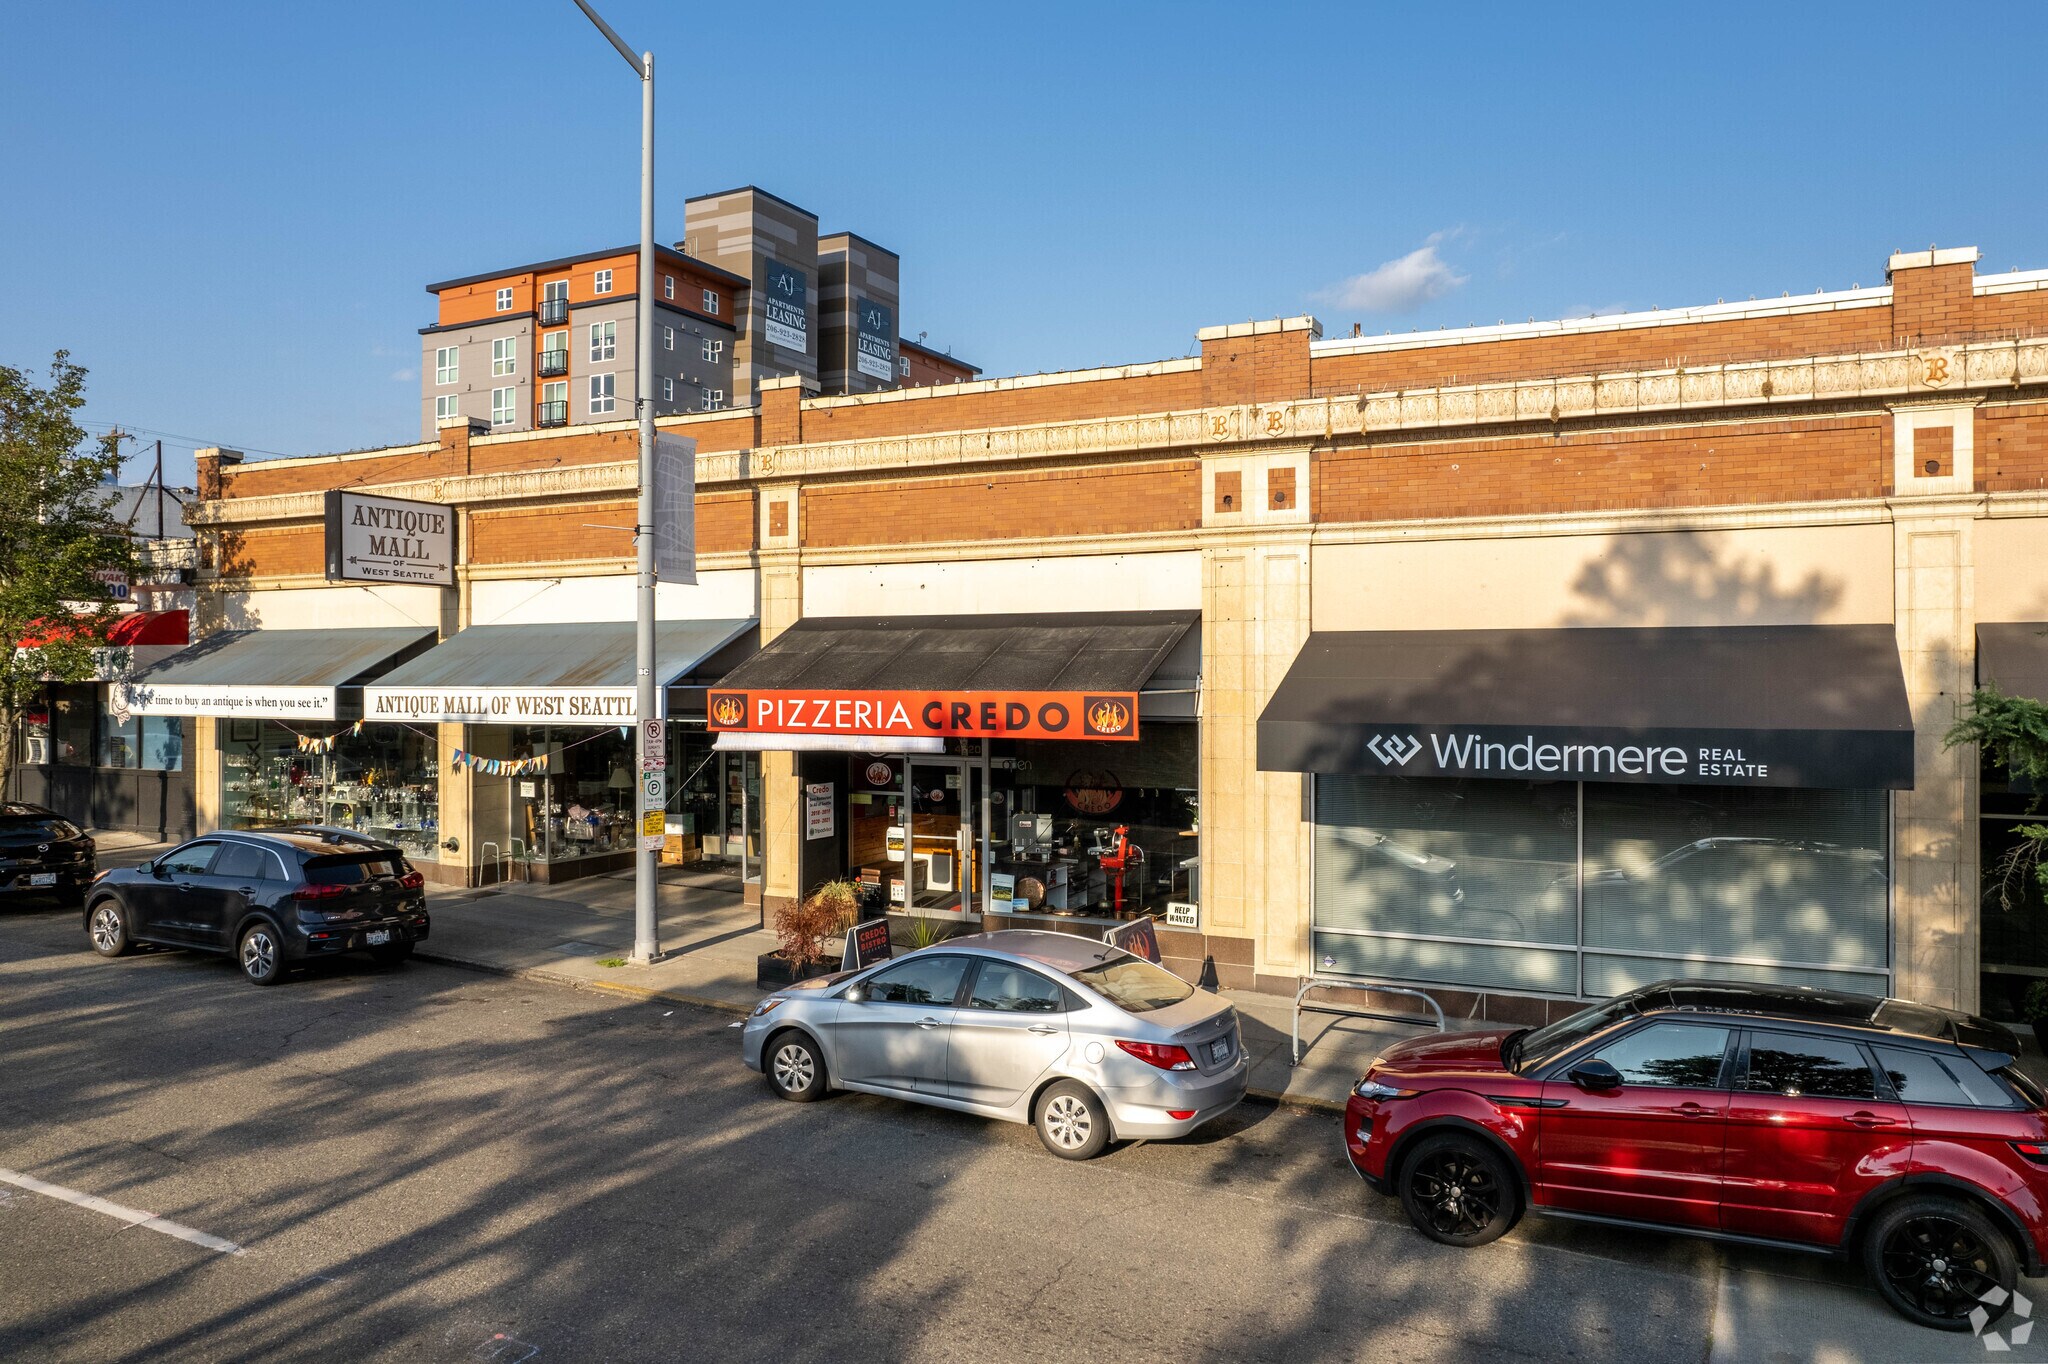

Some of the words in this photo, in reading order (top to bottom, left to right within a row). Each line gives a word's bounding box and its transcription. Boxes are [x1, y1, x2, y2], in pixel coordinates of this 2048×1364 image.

[777, 273, 794, 296] AJ
[767, 297, 805, 316] APARTMENTS
[766, 304, 806, 331] LEASING
[867, 309, 881, 330] AJ
[858, 337, 891, 361] LEASING
[859, 331, 890, 348] APARTMENTS
[350, 504, 445, 537] ANTIQUE
[368, 534, 430, 560] MALL
[392, 559, 405, 567] OF
[155, 694, 173, 706] time
[175, 696, 183, 706] to
[184, 694, 200, 710] buy
[201, 698, 211, 707] an
[213, 695, 244, 711] antique
[246, 696, 253, 708] is
[254, 696, 279, 709] when
[279, 699, 296, 714] you
[297, 700, 312, 709] see
[375, 695, 439, 718] ANTIQUE
[444, 696, 488, 715] MALL
[491, 696, 511, 715] OF
[516, 696, 565, 716] WEST
[569, 696, 637, 717] SEATTL
[719, 717, 739, 726] CREDO
[757, 698, 913, 730] PIZZERIA
[921, 700, 1070, 732] CREDO
[1096, 724, 1122, 734] CREDO
[1429, 733, 1688, 776] Windermere
[1699, 748, 1746, 762] REAL
[1699, 764, 1768, 778] ESTATE
[812, 784, 830, 795] Credo
[1169, 914, 1195, 924] WANTED
[1174, 905, 1191, 915] HELP
[859, 926, 886, 942] CREDO
[860, 935, 887, 952] BISTRO
